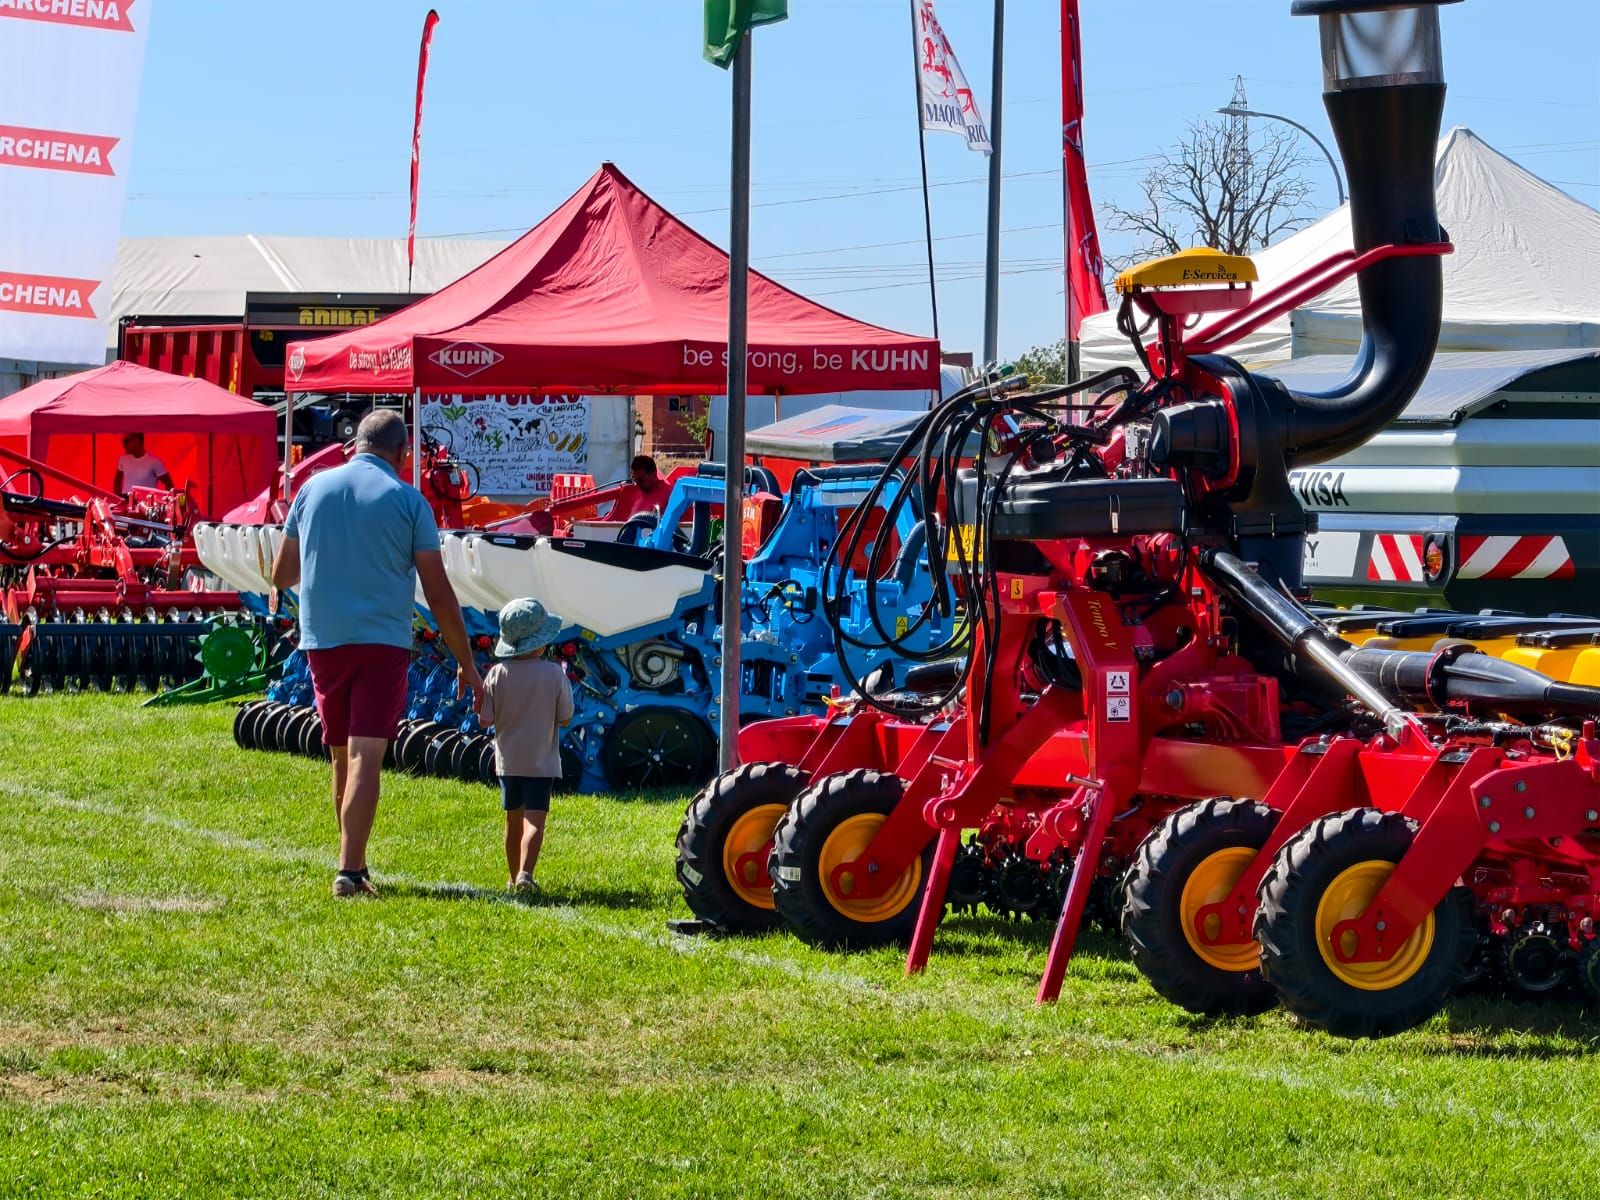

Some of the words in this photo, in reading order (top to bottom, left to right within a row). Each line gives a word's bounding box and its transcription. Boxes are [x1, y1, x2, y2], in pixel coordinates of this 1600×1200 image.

[438, 351, 495, 365] KUHN
[683, 344, 713, 366] be
[721, 350, 804, 374] srong,
[813, 348, 843, 370] be
[851, 350, 929, 371] KUHN
